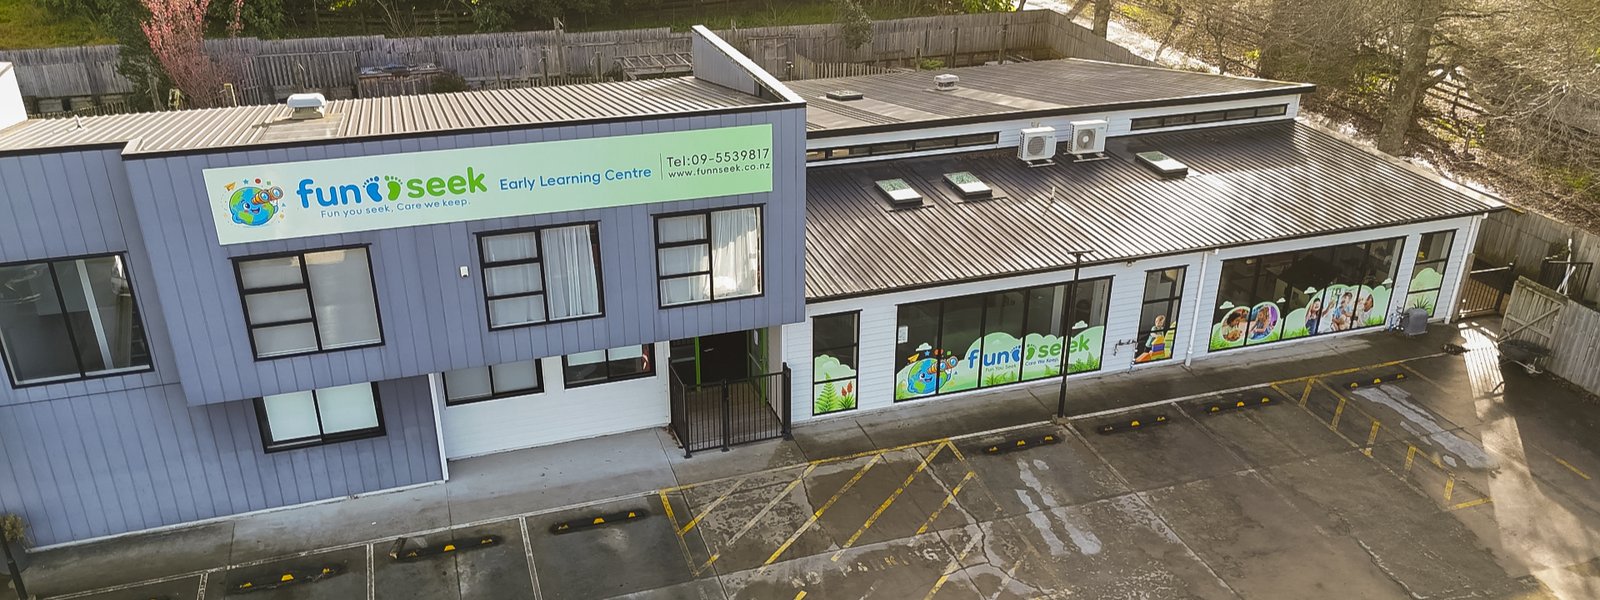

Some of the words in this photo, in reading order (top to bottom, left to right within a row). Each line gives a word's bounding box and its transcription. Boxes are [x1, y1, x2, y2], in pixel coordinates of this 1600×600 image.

[666, 148, 770, 168] Tel:09-5539817
[500, 177, 535, 192] Early
[540, 171, 601, 188] Learning
[604, 166, 652, 182] Centre
[668, 162, 771, 178] www.funnseek.co.nz
[406, 166, 488, 199] seek
[321, 209, 341, 219] Fun
[343, 208, 363, 219] you
[365, 204, 394, 215] seek,
[396, 202, 422, 212] Care
[424, 201, 440, 209] we
[442, 198, 471, 209] keep.
